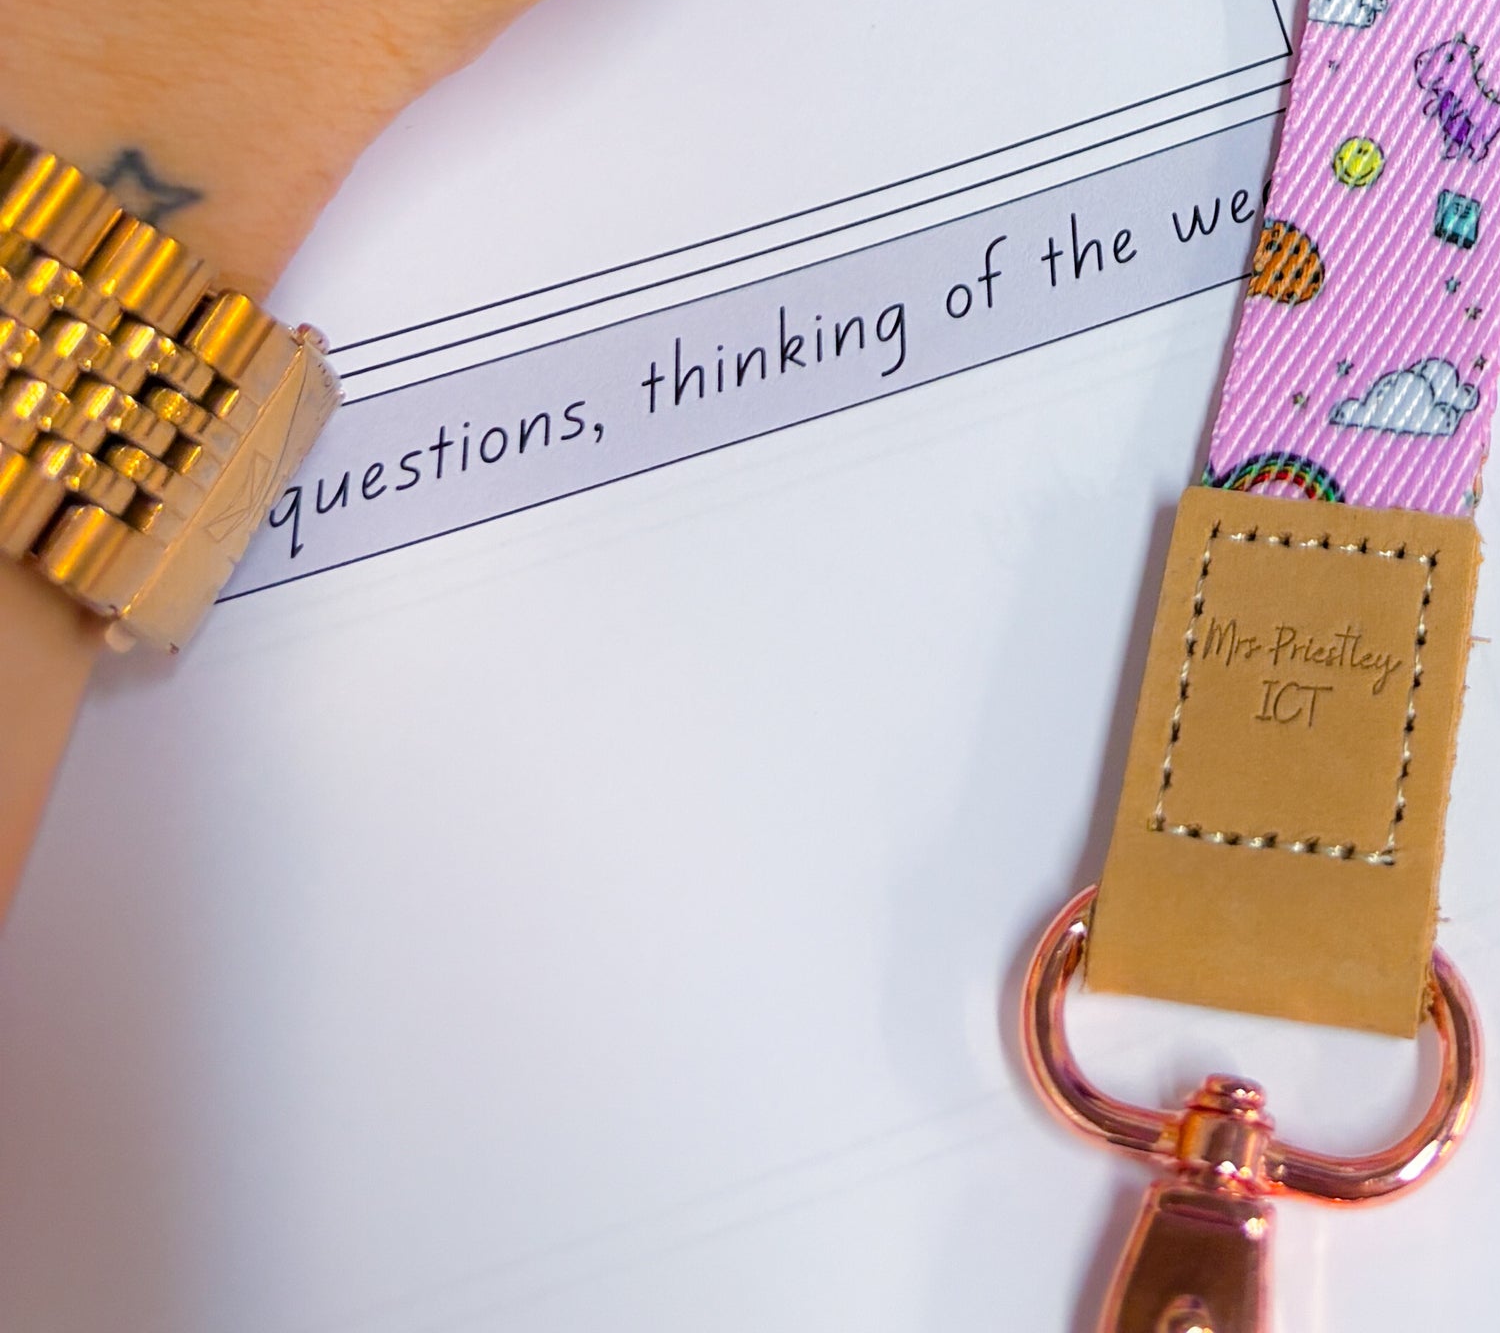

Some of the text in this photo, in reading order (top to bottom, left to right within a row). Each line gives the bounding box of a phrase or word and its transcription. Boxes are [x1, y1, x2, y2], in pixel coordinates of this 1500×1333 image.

[268, 399, 605, 559] questions,
[641, 301, 906, 414] thinking
[945, 234, 1009, 319] of
[1040, 212, 1138, 287] the
[1202, 616, 1404, 696] Mrs Priestley
[1253, 679, 1334, 728] ICT
